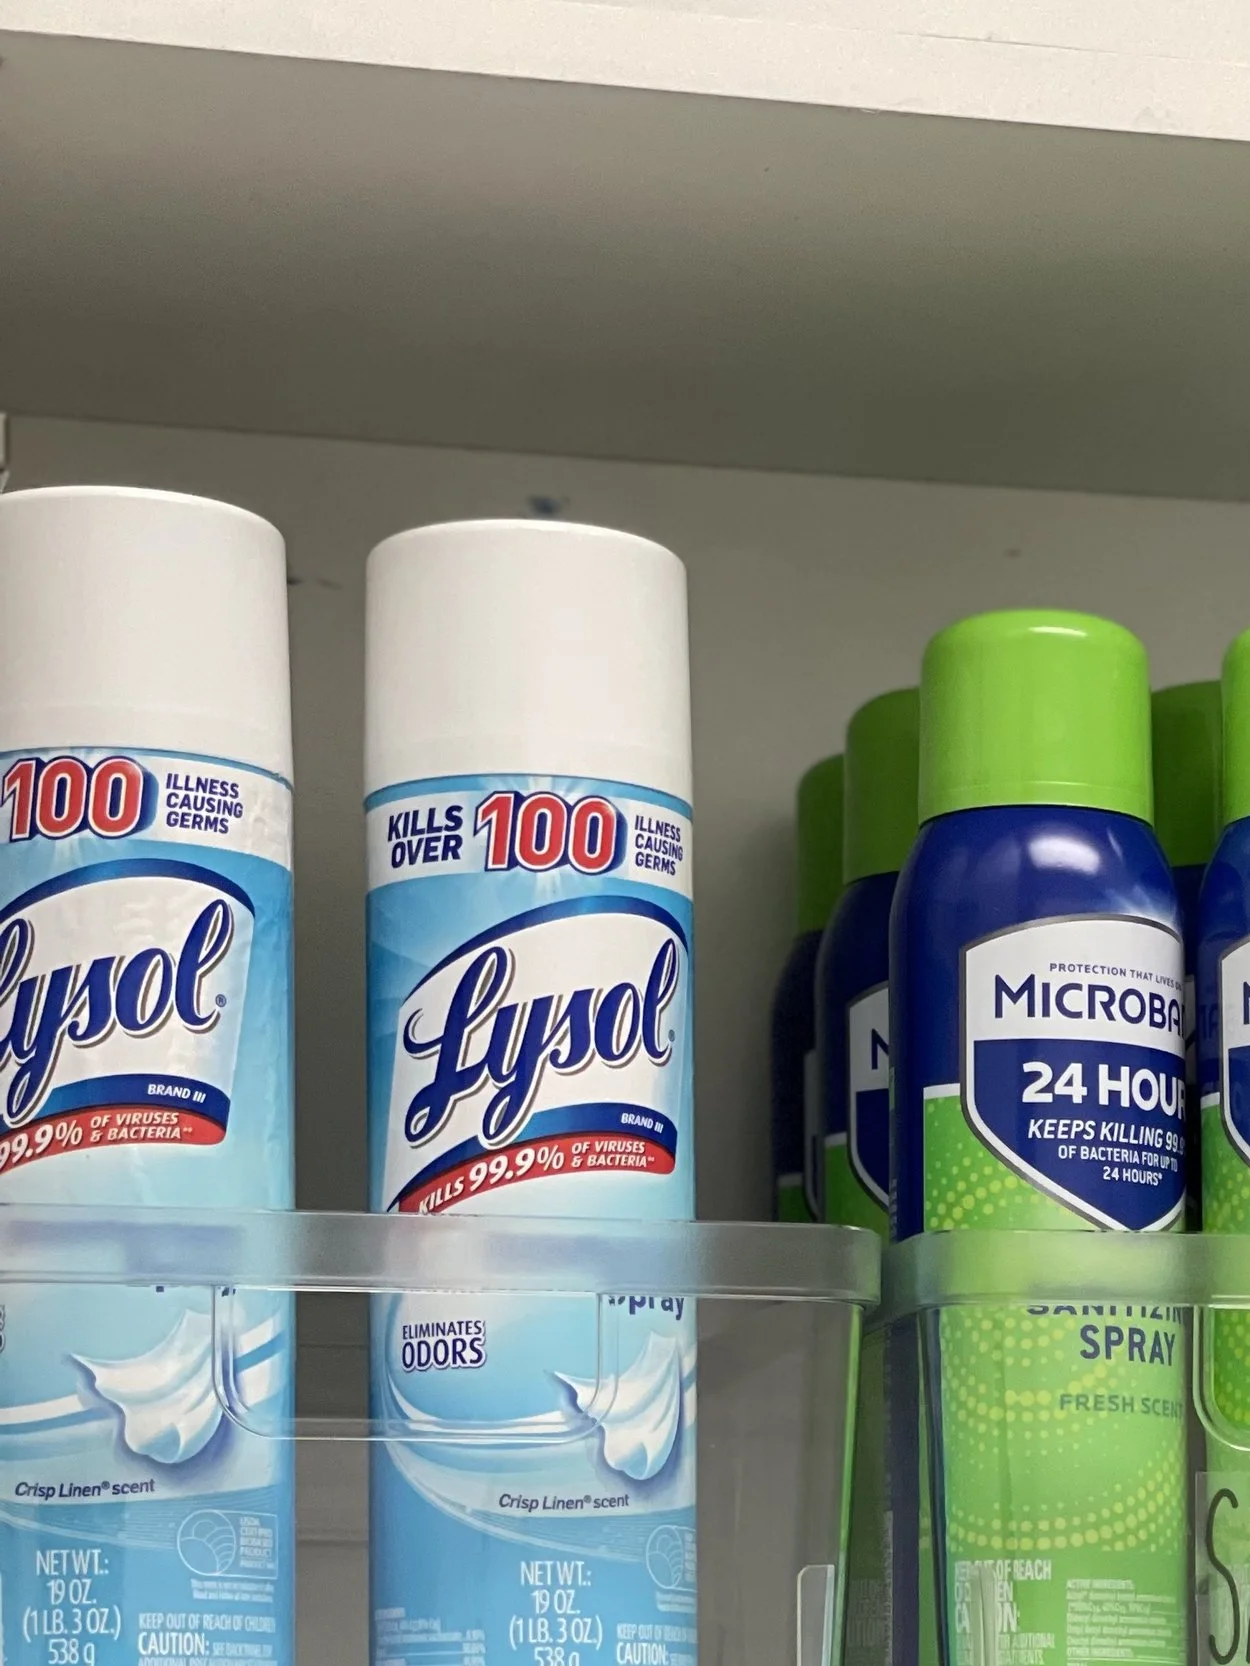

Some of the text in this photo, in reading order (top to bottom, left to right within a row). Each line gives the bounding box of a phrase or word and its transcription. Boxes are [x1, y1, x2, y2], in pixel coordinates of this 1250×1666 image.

[166, 773, 239, 799] ILLNESS
[2, 757, 150, 841] 100
[166, 793, 243, 818] CAUSING
[166, 811, 229, 833] GERMS
[388, 805, 463, 841] KILLS
[474, 791, 620, 874] 100
[635, 816, 680, 842] ILLNESS
[391, 834, 463, 868] OVER
[635, 834, 683, 861] CAUSING
[635, 853, 676, 876] GERMS
[1050, 963, 1175, 987] PROTECTION THAT LIVES
[148, 1084, 190, 1099] BRAND
[1022, 1061, 1087, 1104] 24
[90, 1112, 179, 1128] OF VIRUSES
[621, 1113, 653, 1129] BRAND
[90, 1131, 102, 1142] &
[1028, 1119, 1096, 1140] KEEPS
[1100, 1122, 1163, 1148] KILLING
[572, 1142, 645, 1155] OF VIRUSES
[1058, 1145, 1076, 1159] OF
[1080, 1146, 1139, 1164] BACTERIA
[1141, 1152, 1159, 1168] FOR
[1160, 1155, 1170, 1169] UP
[572, 1156, 582, 1167] &
[1103, 1166, 1119, 1180] 24
[419, 1145, 565, 1213] KILLS 99.9%
[402, 1320, 483, 1340] ELIMINATES
[402, 1338, 484, 1369] ODORS
[1080, 1324, 1176, 1367] SPRAY
[1060, 1394, 1184, 1420] FRESH SCENT
[15, 1482, 55, 1500] Crisp
[112, 1479, 155, 1495] scent
[499, 1493, 539, 1512] Crisp
[593, 1493, 630, 1508] scent
[36, 1550, 71, 1575] NET
[520, 1561, 553, 1585] NET
[1014, 1560, 1051, 1580] REACH
[47, 1579, 97, 1604] 19 OZ.
[532, 1591, 580, 1614] 19 OZ.
[44, 1610, 68, 1634] LB.
[72, 1610, 82, 1634] 3
[139, 1613, 164, 1630] KEEP
[166, 1613, 186, 1629] OUT
[188, 1613, 200, 1629] OF
[203, 1614, 231, 1631] REACH
[528, 1619, 552, 1644] LB.
[557, 1619, 567, 1643] 3
[48, 1639, 78, 1664] 538
[138, 1632, 209, 1655] CAUTION:
[616, 1642, 669, 1666] CAUTION:
